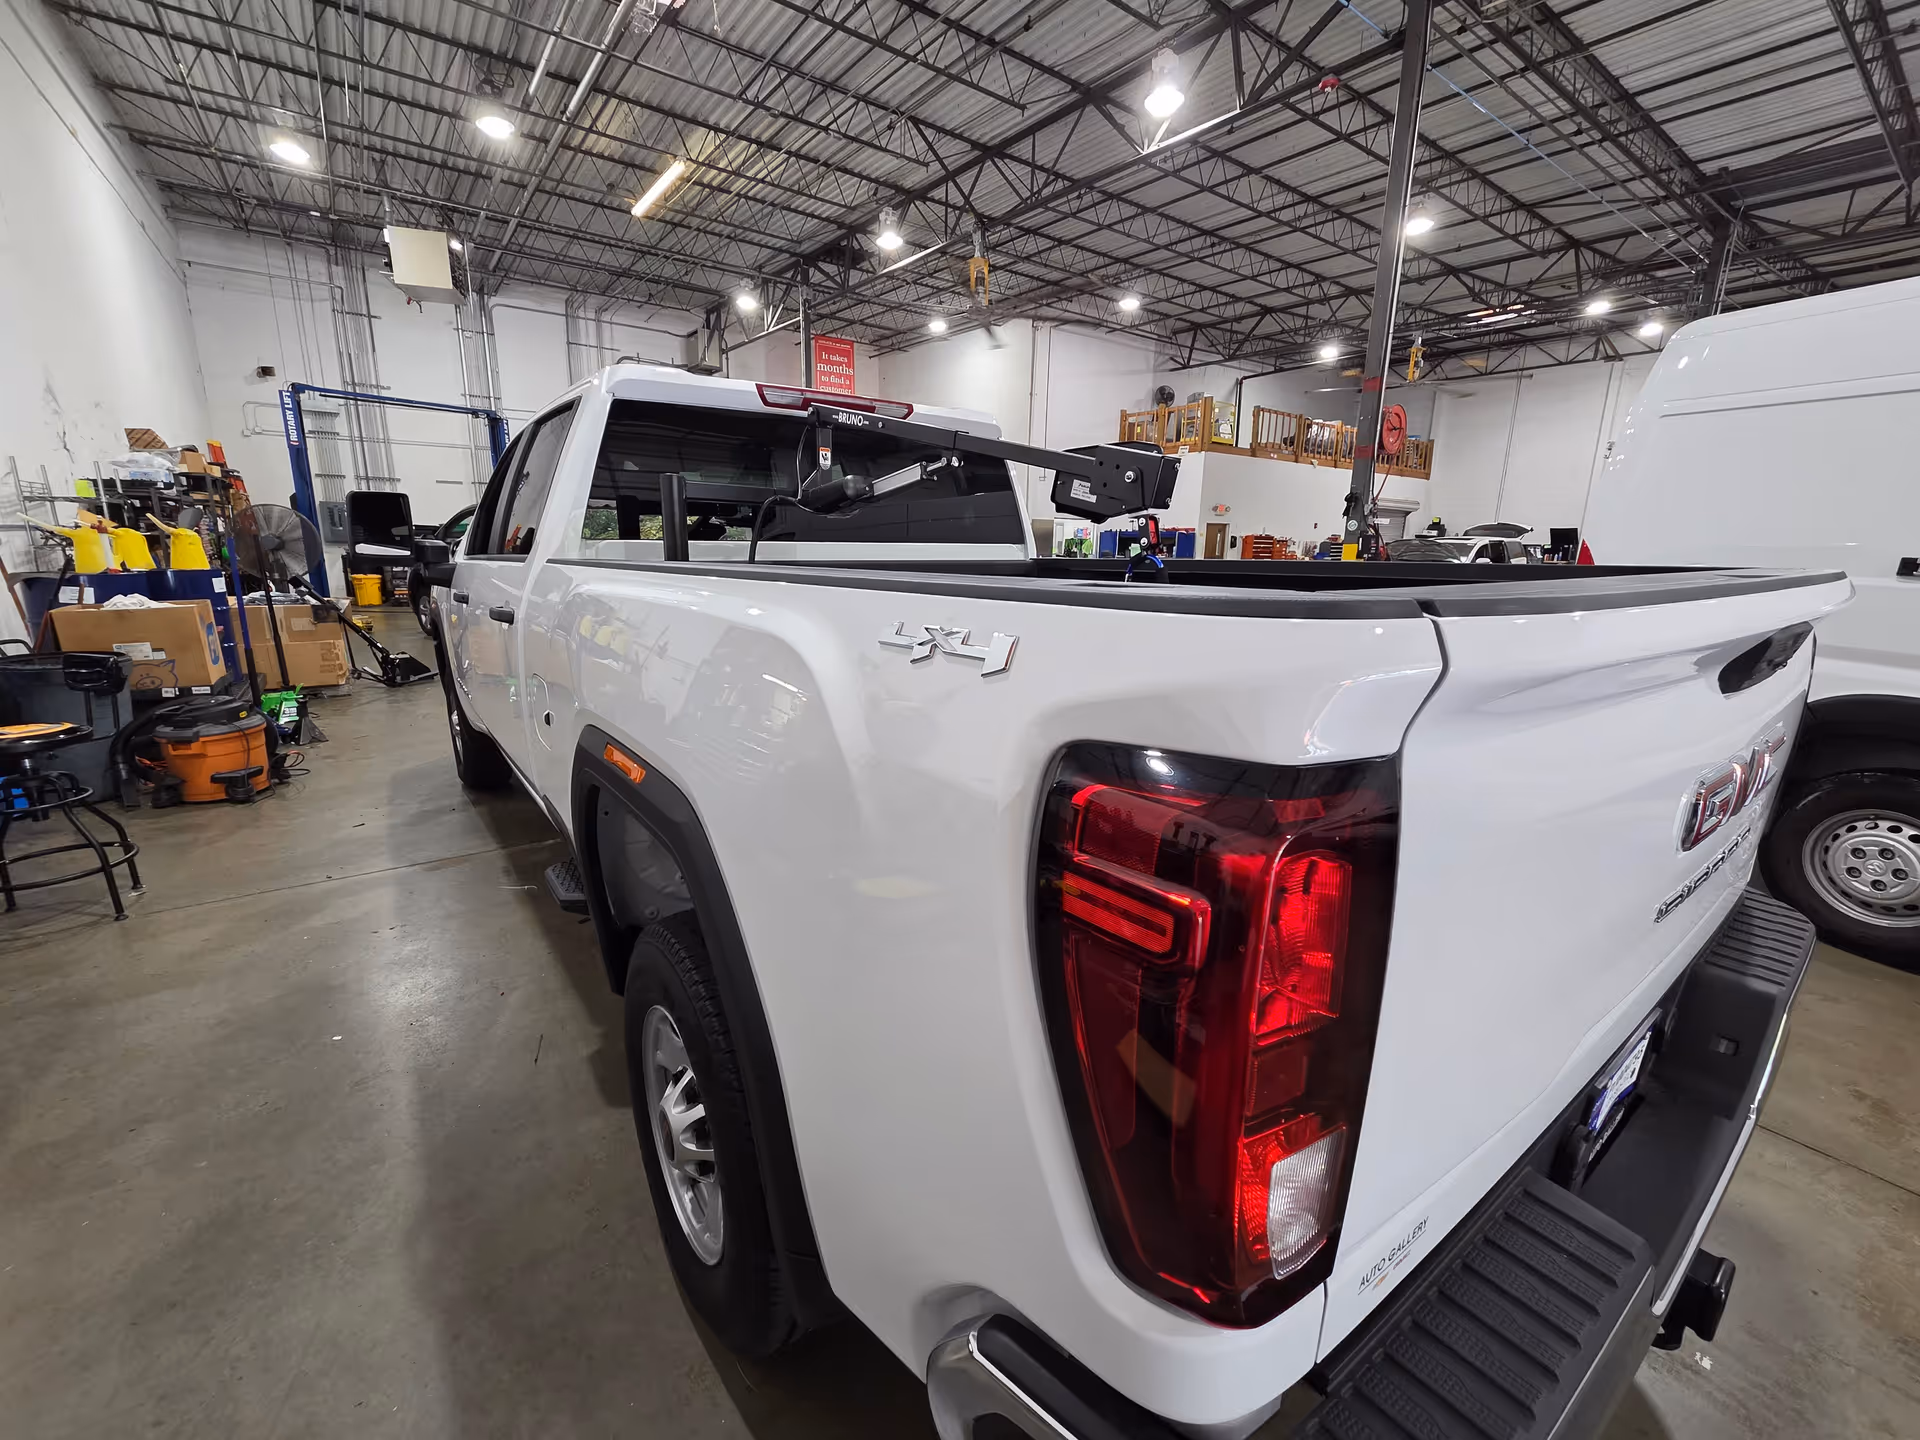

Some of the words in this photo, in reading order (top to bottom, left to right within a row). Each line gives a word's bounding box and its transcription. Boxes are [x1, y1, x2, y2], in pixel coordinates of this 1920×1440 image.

[821, 351, 829, 360] It
[829, 353, 848, 363] takes
[816, 363, 854, 376] months
[830, 375, 844, 385] find
[819, 385, 852, 395] customer
[282, 391, 292, 408] LIFT
[285, 409, 298, 441] ROTARY
[838, 411, 864, 427] BRUNO
[1358, 1257, 1386, 1291] AUTO
[1387, 1216, 1430, 1262] GALLERY
